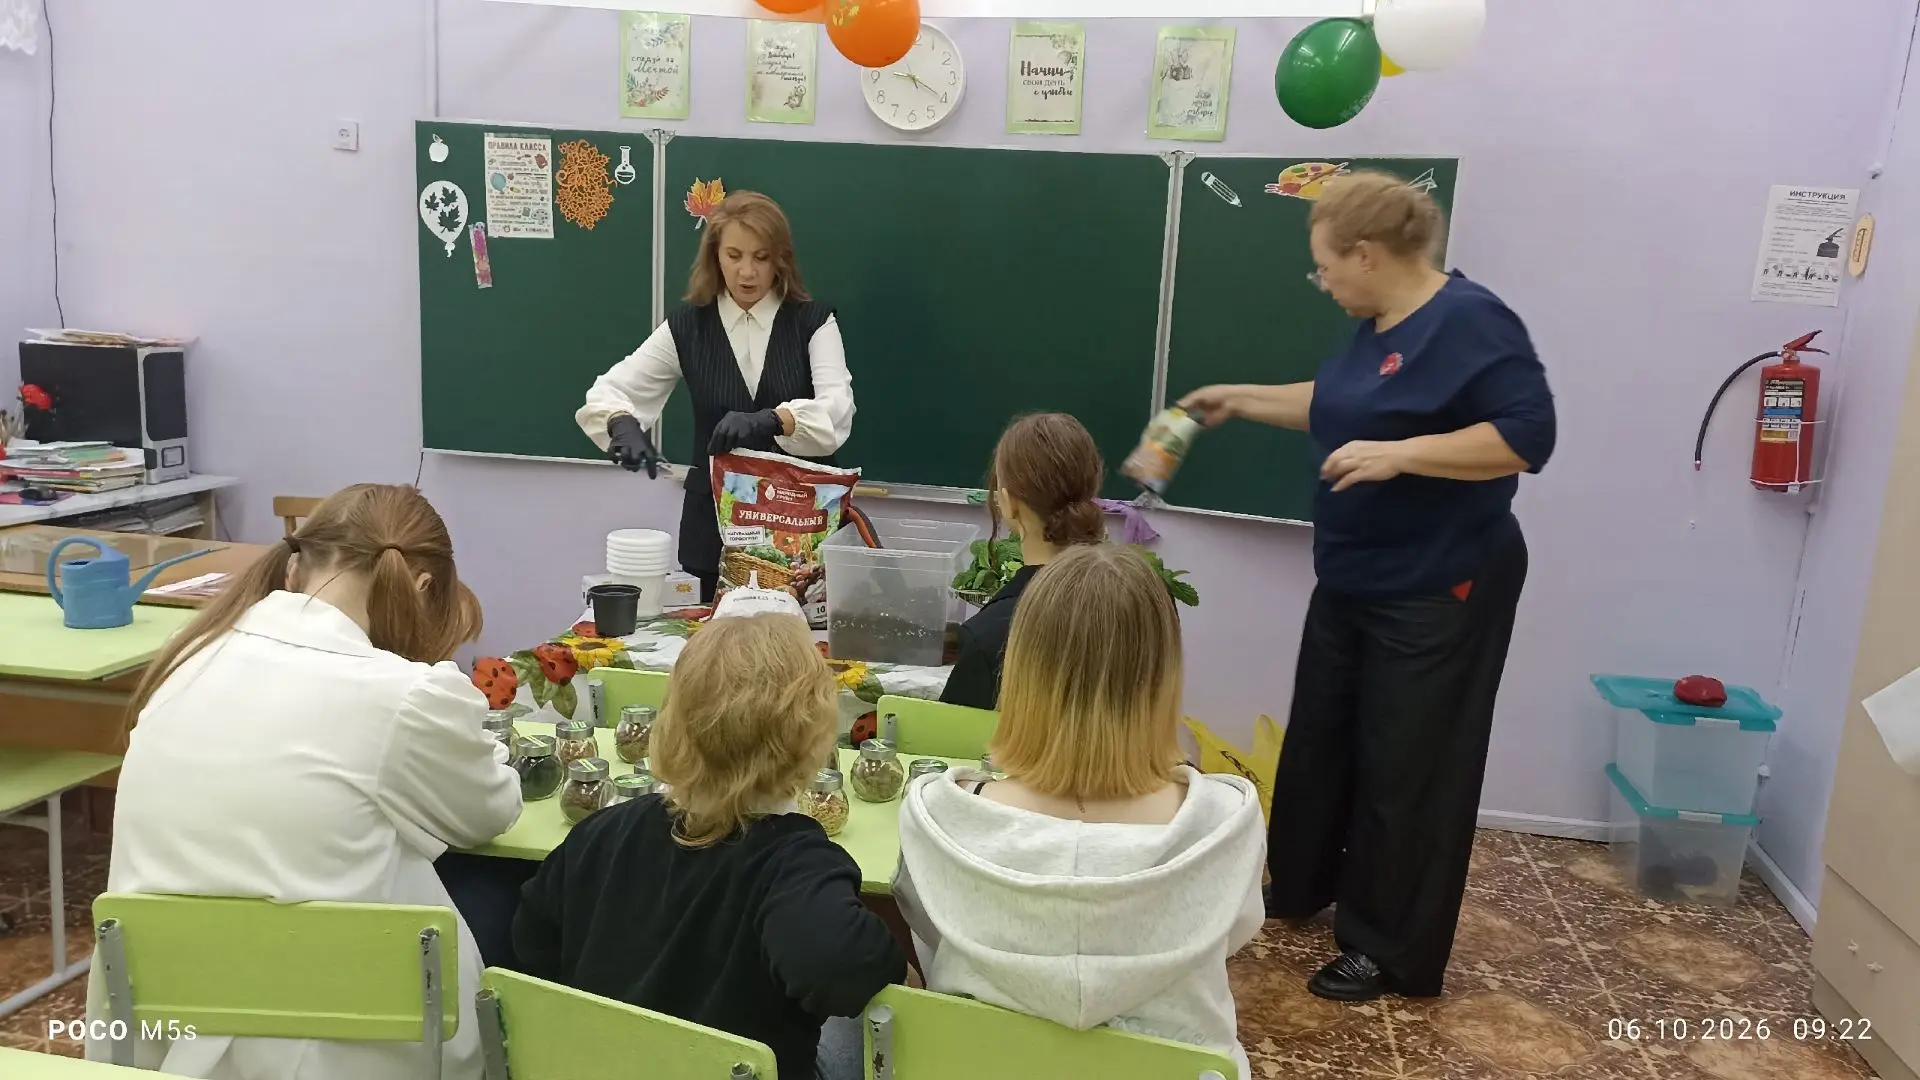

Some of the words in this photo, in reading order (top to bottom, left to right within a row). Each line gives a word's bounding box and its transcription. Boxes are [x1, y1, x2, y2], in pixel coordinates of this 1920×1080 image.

[941, 50, 952, 66] 2
[870, 70, 880, 84] 9
[948, 70, 957, 86] 3
[876, 90, 886, 104] 8
[939, 91, 948, 104] 4
[891, 103, 899, 118] 7
[907, 109, 917, 123] 6
[926, 105, 936, 119] 5
[487, 141, 518, 150] ПРАВИЛА
[520, 142, 547, 151] КЛАССА
[1789, 190, 1846, 200] ИНСТРУКЦИЯ
[738, 509, 824, 526] УНИВЕРСАЛЬНЫЙ
